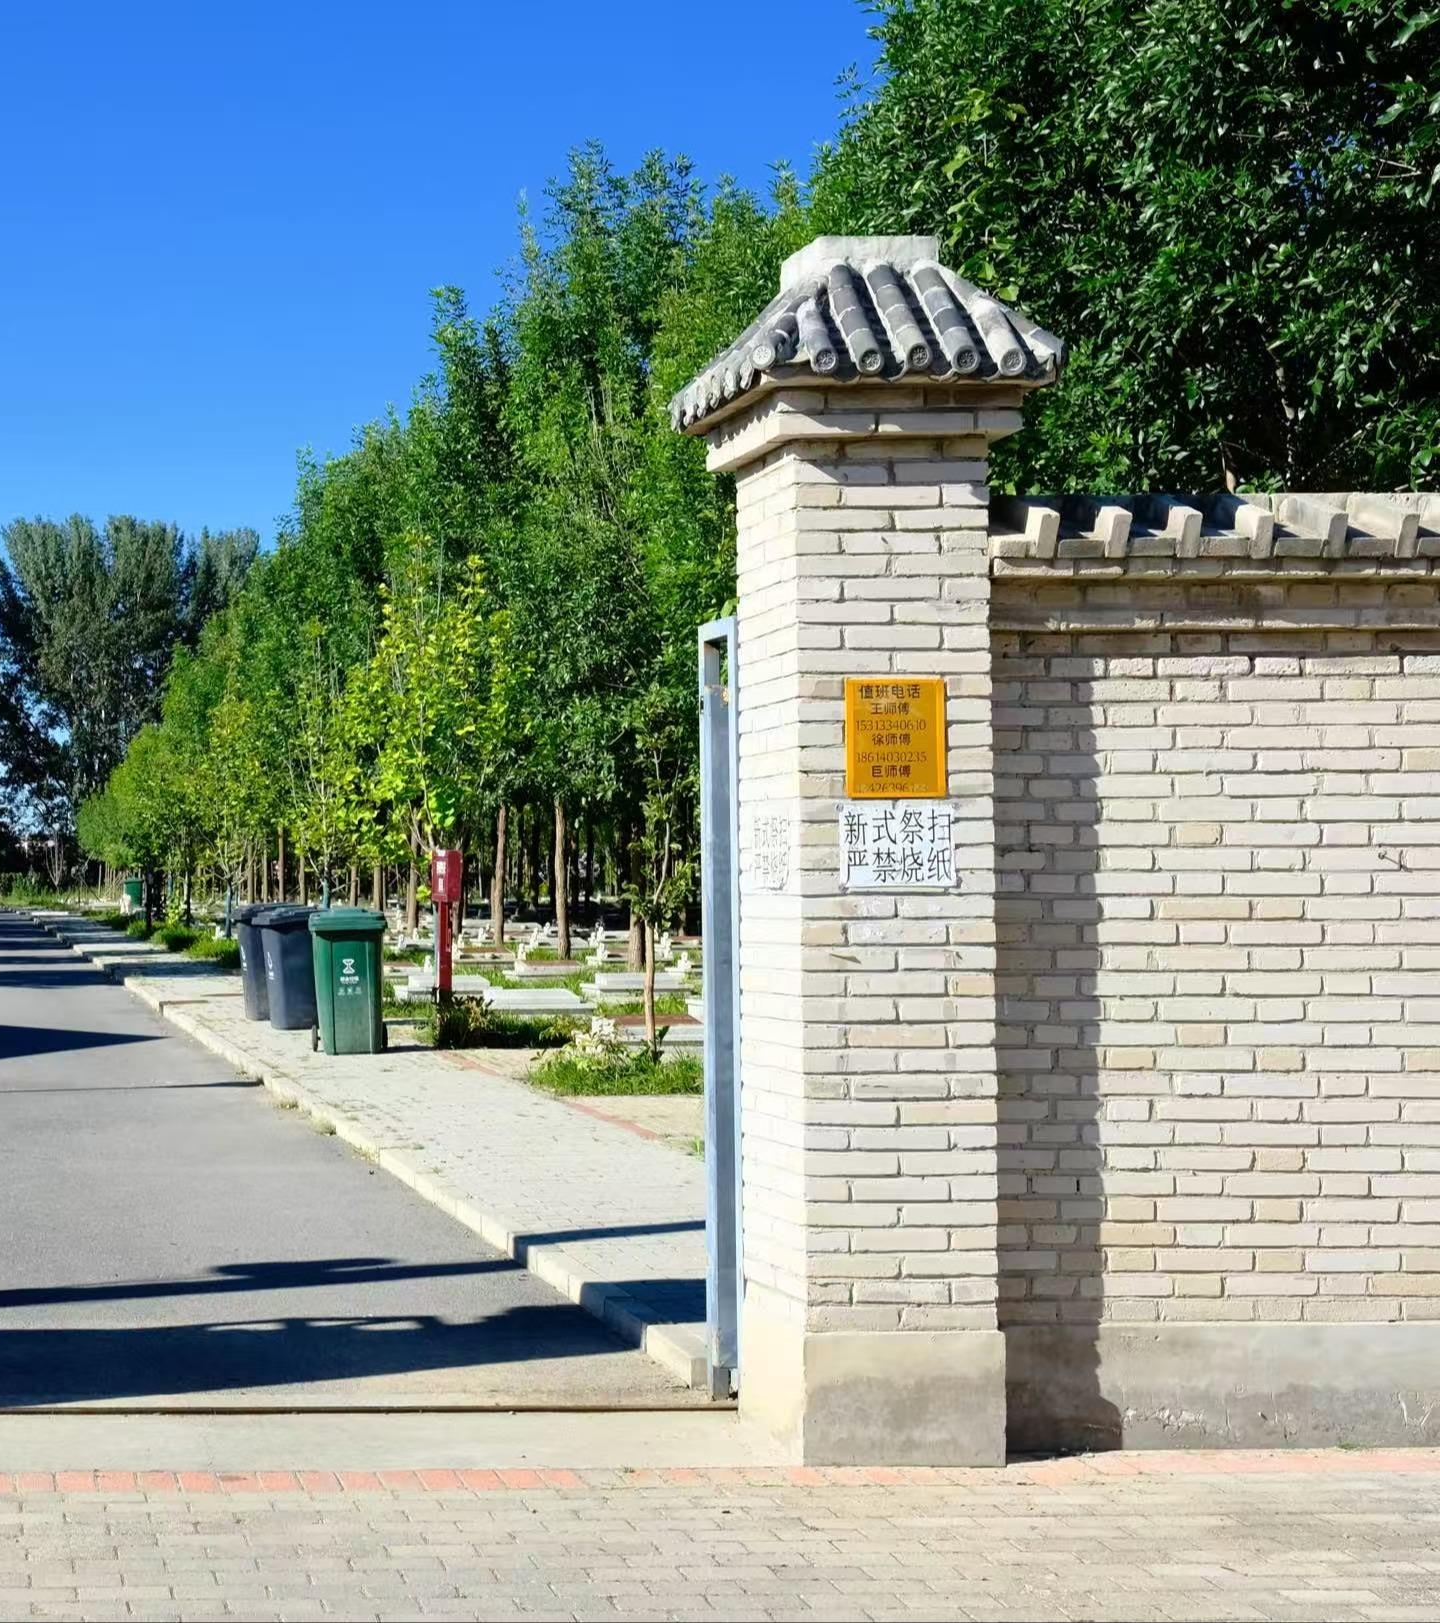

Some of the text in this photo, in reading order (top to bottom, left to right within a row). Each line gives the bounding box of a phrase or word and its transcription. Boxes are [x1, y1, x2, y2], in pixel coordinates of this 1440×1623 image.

[859, 684, 921, 699] 值班电话
[870, 702, 910, 715] 王师傅
[872, 733, 911, 746] 徐师傅
[843, 809, 951, 845] 新式祭扫
[844, 847, 952, 884] 严禁烧纸
